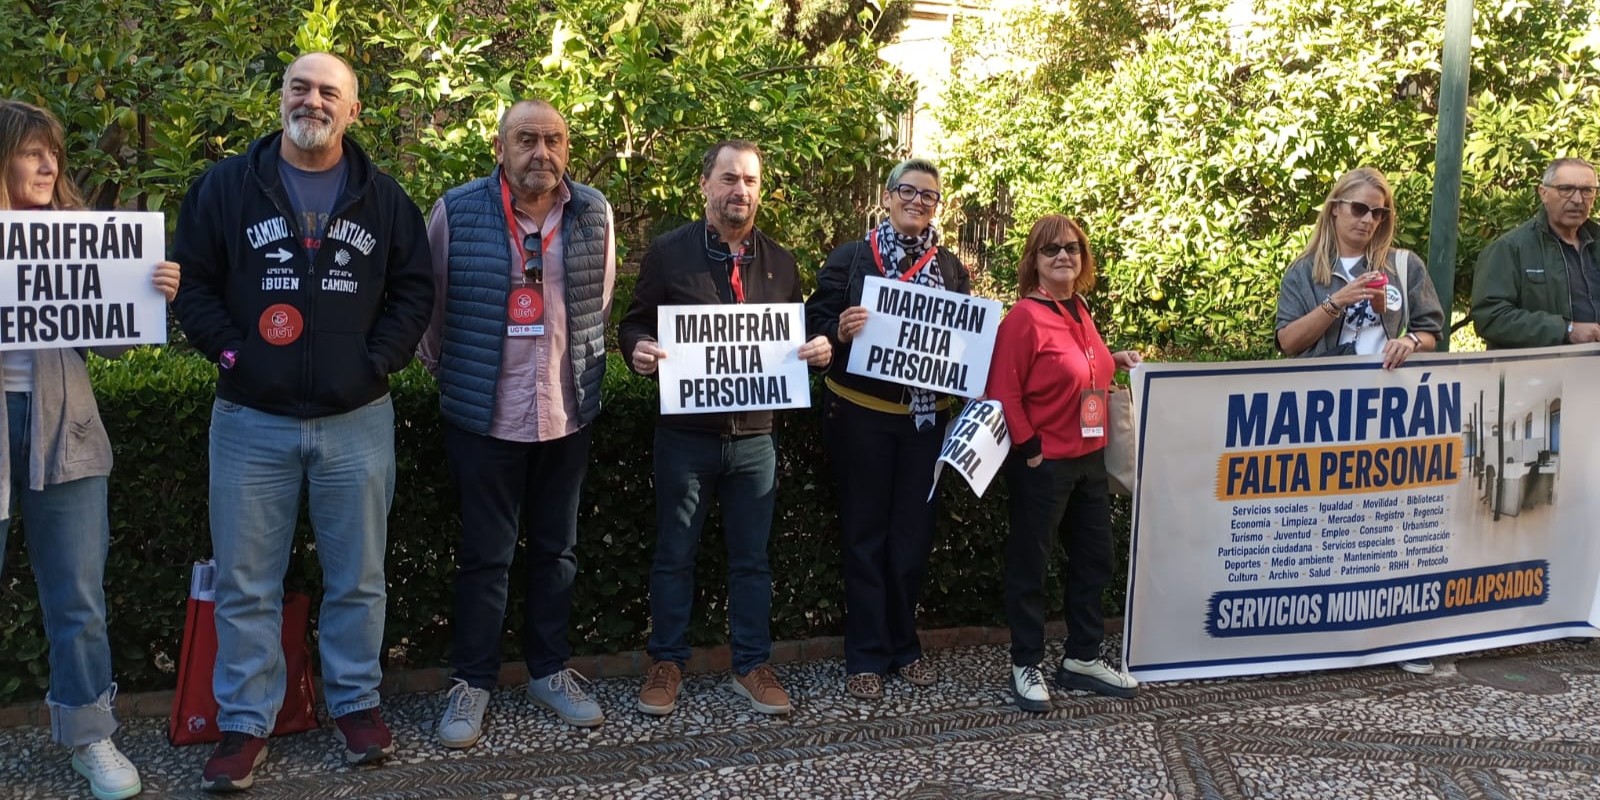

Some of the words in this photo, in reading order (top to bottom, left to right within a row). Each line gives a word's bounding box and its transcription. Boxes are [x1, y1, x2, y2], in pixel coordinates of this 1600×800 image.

[0, 217, 143, 260] ARIFRÁN
[246, 216, 289, 249] CAMINO
[17, 263, 102, 301] FALTA
[261, 277, 299, 290] ¡BUEN
[321, 278, 358, 293] CAMINO!
[675, 308, 790, 343] MARIFRÁN
[876, 286, 986, 334] MARIFRÁN
[267, 326, 294, 339] UGT
[897, 321, 952, 357] FALTA
[705, 345, 763, 375] FALTA
[866, 345, 968, 392] PERSONAL
[679, 375, 792, 408] PERSONAL
[1225, 372, 1462, 448] MARIFRÁN
[1226, 452, 1311, 496] FALTA
[1319, 442, 1457, 491] PERSONAL
[1231, 518, 1271, 530] Economía
[1281, 516, 1318, 528] Limpieza
[1327, 513, 1365, 524] Mercados
[1375, 510, 1405, 522] Registro
[1413, 506, 1444, 518] Regencia
[1232, 505, 1271, 516] Servicios
[1274, 503, 1308, 514] sociales
[1319, 501, 1353, 513] Igualdad
[1362, 496, 1398, 509] Movilidad
[1407, 494, 1444, 505] Bibliotecas
[1218, 545, 1270, 557] Participación
[1272, 543, 1312, 554] ciudadana
[1322, 539, 1356, 551] Servicios
[1357, 537, 1395, 549] especiales
[1403, 530, 1450, 544] Comunicación
[1231, 532, 1263, 543] Turismo
[1273, 529, 1311, 541] Juventud
[1321, 527, 1350, 539] Empleo
[1359, 524, 1393, 535] Consumo
[1402, 520, 1439, 531] Urbanismo
[1224, 560, 1261, 571] Deportes
[1271, 556, 1296, 567] Medio
[1298, 554, 1334, 566] ambiente
[1343, 549, 1398, 562] Mantenimiento
[1405, 544, 1444, 556] Informática
[1228, 572, 1258, 583] Cultura
[1268, 569, 1299, 580] Archivo
[1309, 567, 1331, 578] Salud
[1340, 563, 1380, 575] Patrimonio
[1388, 560, 1409, 571] RRHH
[1417, 555, 1448, 568] Protocolo
[1217, 593, 1323, 630] SERVICIOS
[1327, 580, 1441, 624] MUNICIPALES
[1444, 567, 1544, 609] COLAPSADOS
